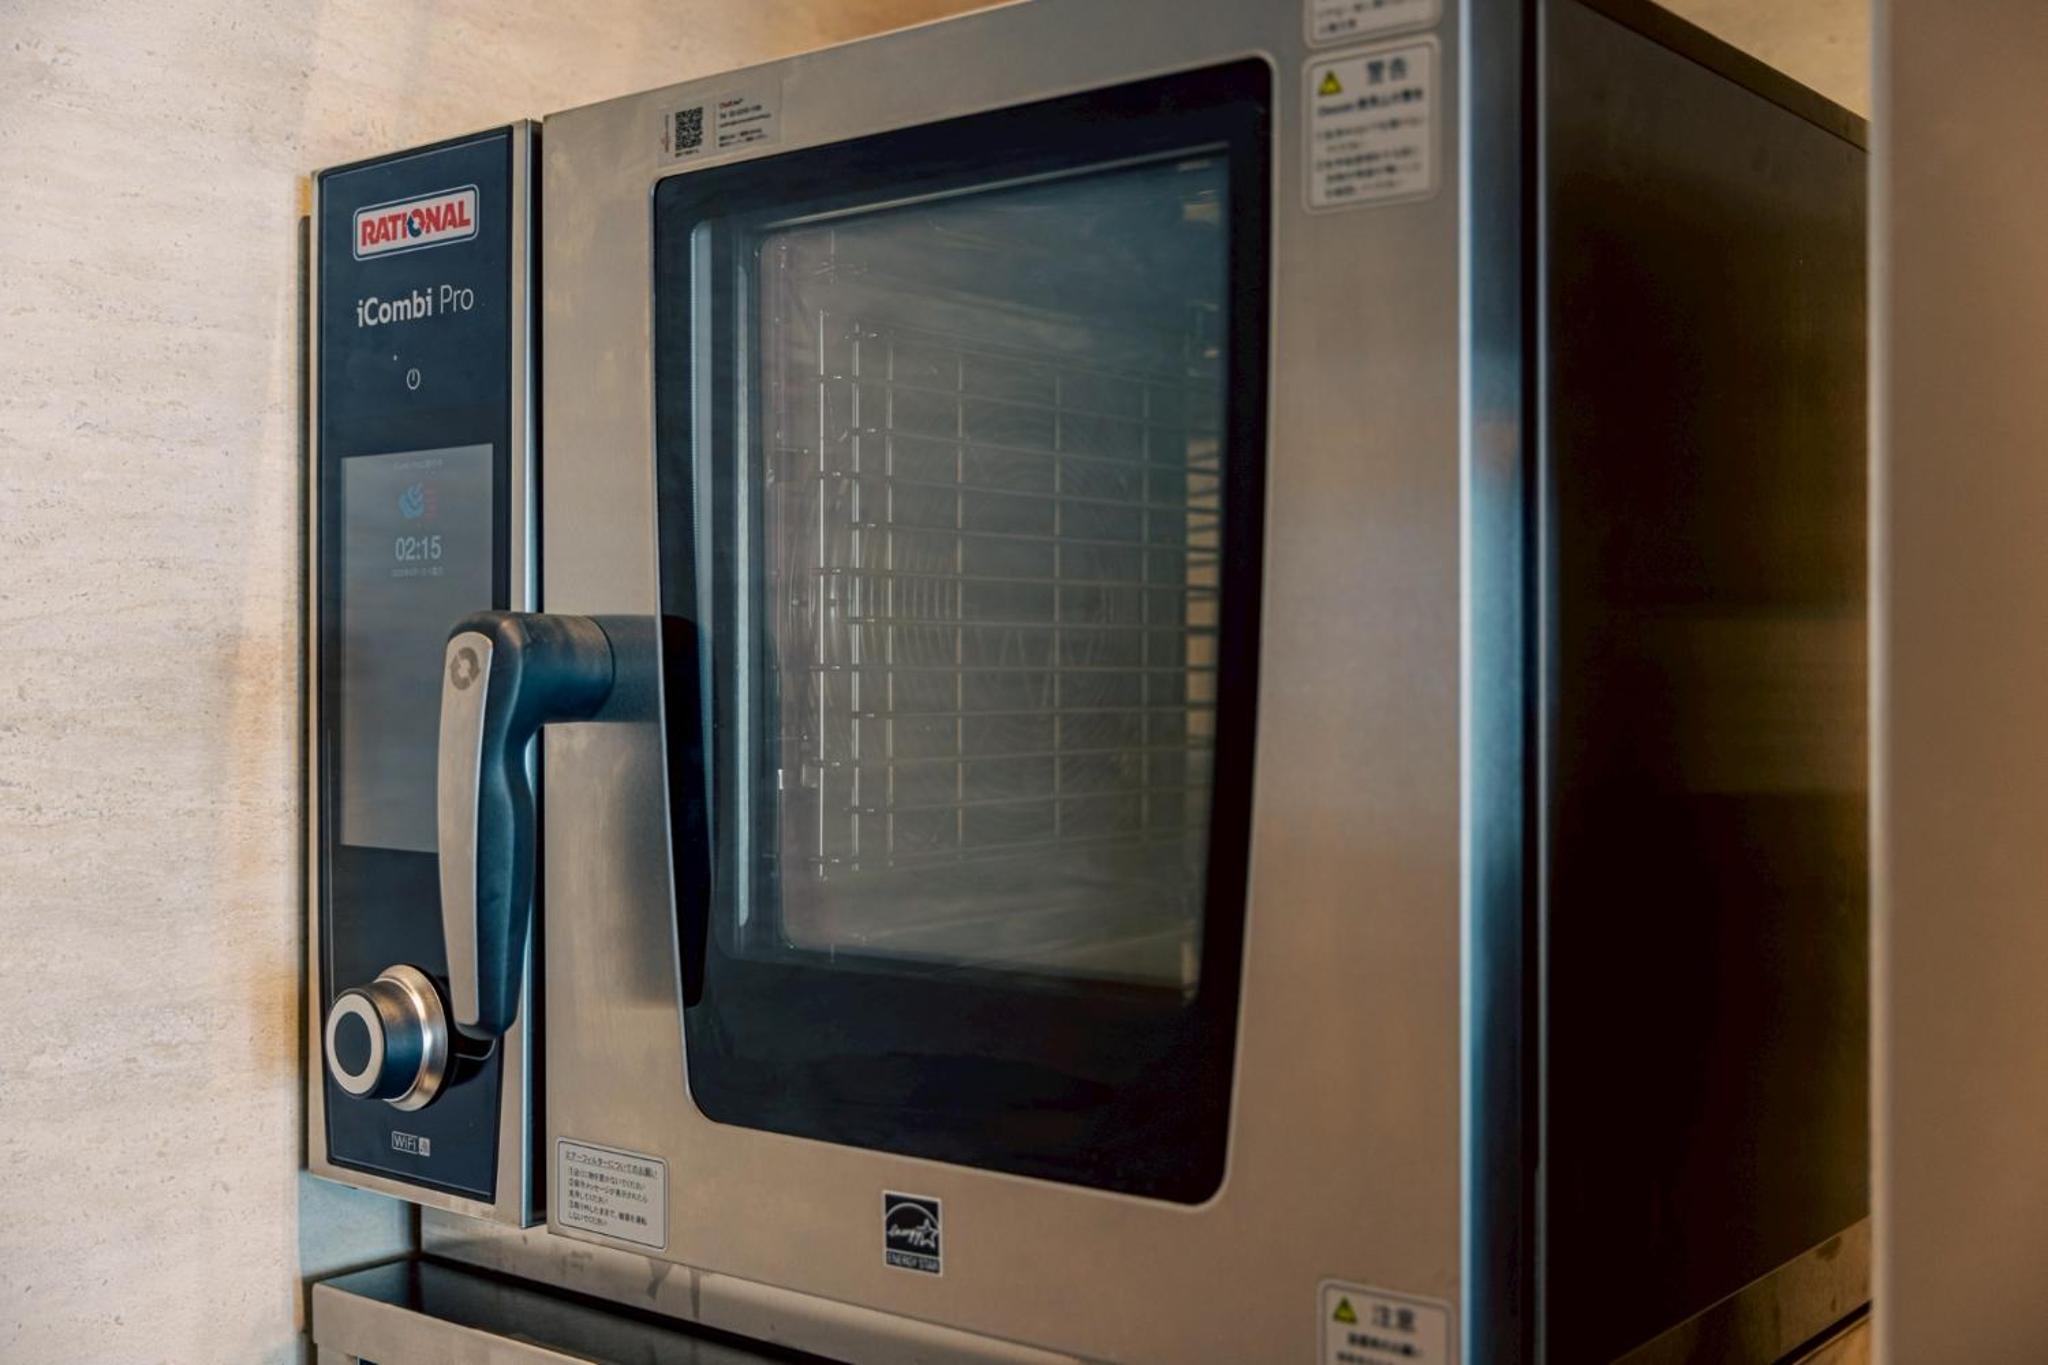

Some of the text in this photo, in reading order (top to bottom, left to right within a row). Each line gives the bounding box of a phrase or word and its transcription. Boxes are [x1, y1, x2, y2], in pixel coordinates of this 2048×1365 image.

[361, 200, 471, 247] RATIONAL
[356, 284, 474, 328] iCombi Pro
[395, 535, 442, 561] 02:15
